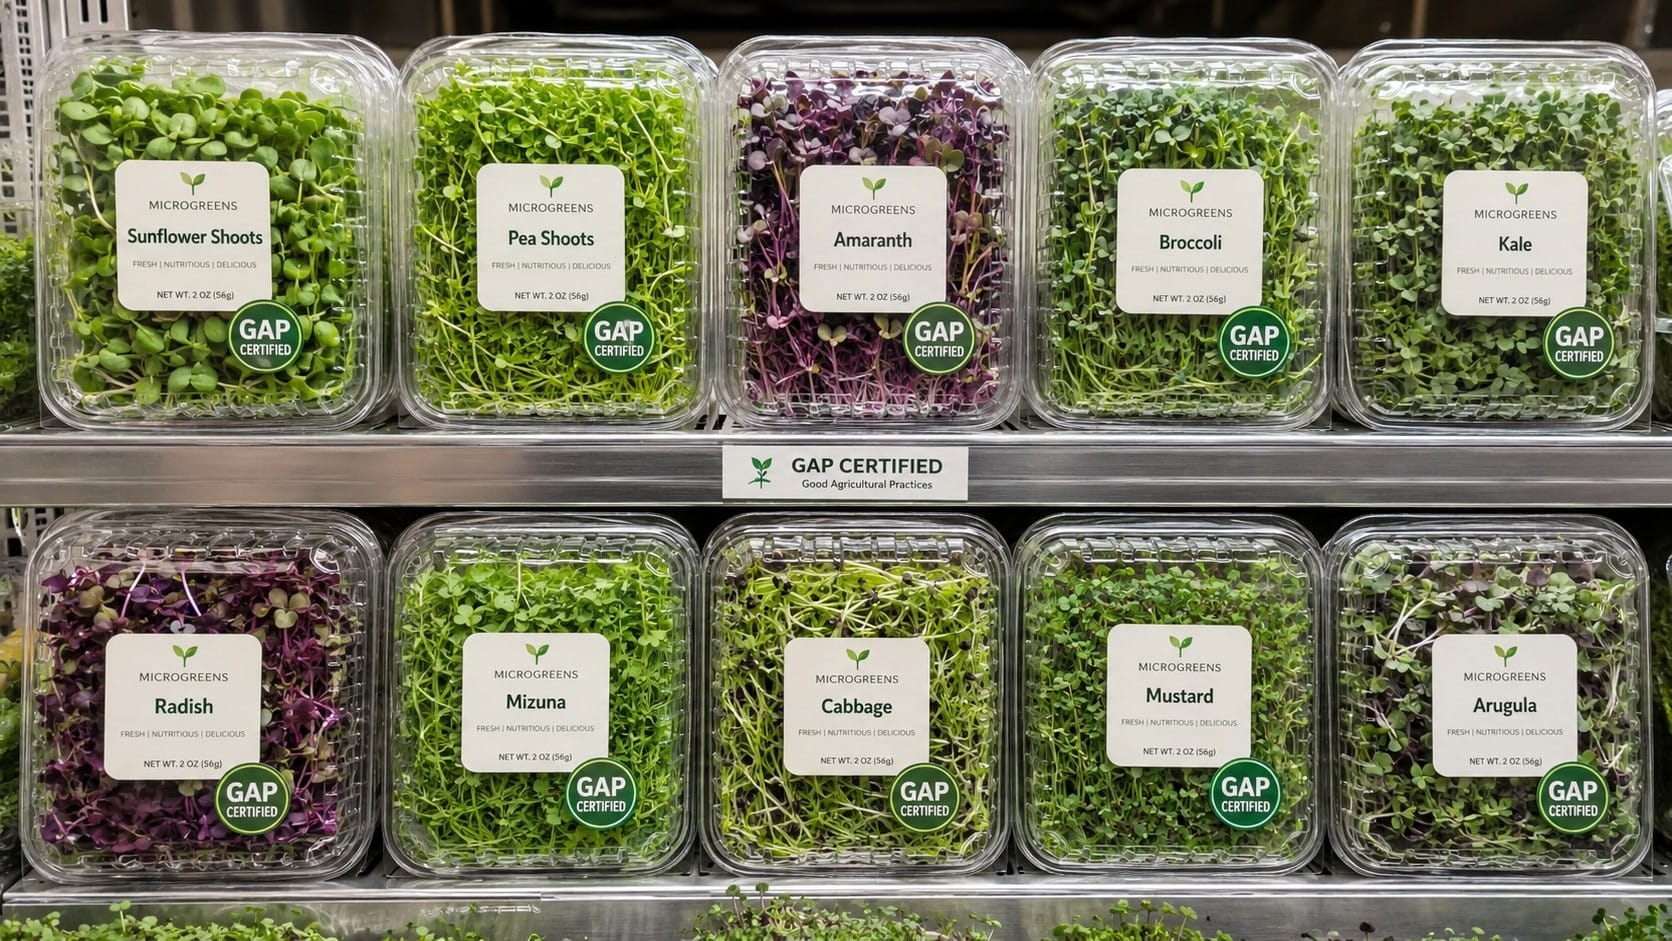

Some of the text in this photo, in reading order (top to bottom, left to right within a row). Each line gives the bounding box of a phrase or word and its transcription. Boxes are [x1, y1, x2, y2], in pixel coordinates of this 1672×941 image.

[149, 200, 238, 211] MICROGREENS
[508, 203, 594, 213] MICROGREENS
[831, 205, 916, 215] MICROGREENS
[1149, 208, 1233, 218] MICROGREENS
[1474, 209, 1557, 219] MICROGREENS
[128, 228, 263, 245] Sunflower Shoots
[509, 230, 594, 246] Pea Shoots
[834, 231, 912, 248] Amaranth
[1160, 234, 1222, 250] Broccoli
[1499, 236, 1532, 252] Kale
[133, 260, 158, 268] FRESH
[216, 261, 257, 269] DELICIOUS
[521, 262, 566, 270] NUTRITIOUS
[572, 262, 611, 270] DELICIOUS
[814, 263, 837, 271] FRESH
[843, 263, 888, 271] NUTRITIOUS
[1131, 265, 1154, 273] FRESH
[1210, 266, 1249, 274] DELICIOUS
[1486, 267, 1529, 275] NUTRITIOUS
[157, 291, 234, 301] NET WT. 2 OZ (56g)
[532, 292, 547, 300] WT.
[548, 292, 554, 300] 2
[555, 292, 567, 300] OZ
[568, 292, 589, 302] (56g)
[836, 293, 910, 303] NET WT. 2 OZ (56g)
[1193, 295, 1204, 303] OZ
[1206, 295, 1226, 304] (56g)
[1479, 296, 1494, 304] NET
[1531, 297, 1551, 306] (56g)
[239, 319, 291, 340] GAP
[594, 320, 644, 342] GAP
[914, 321, 964, 342] GAP
[1230, 326, 1280, 346] GAP
[1555, 326, 1604, 346] GAP
[240, 344, 291, 356] CERTIFIED
[595, 346, 644, 358] CERTIFIED
[915, 346, 964, 358] CERTIFIED
[1230, 349, 1279, 362] CERTIFIED
[1556, 350, 1603, 362] CERTIFIED
[792, 458, 943, 474] GAP CERTIFIED
[802, 479, 933, 491] Good Agricultural Practices
[1138, 662, 1221, 672] MICROGREENS
[139, 672, 228, 682] MICROGREENS
[494, 670, 578, 679] MICROGREENS
[816, 675, 899, 684] MICROGREENS
[1464, 672, 1546, 682] MICROGREENS
[507, 694, 566, 709] Mizuna
[1146, 687, 1213, 704] Mustard
[155, 697, 213, 714] Radish
[822, 698, 892, 718] Cabbage
[1473, 697, 1537, 717] Arugula
[1121, 718, 1144, 726] FRESH
[1199, 719, 1238, 727] DELICIOUS
[120, 730, 245, 738] FRESH NUTRITIOUS DELICIOUS
[1476, 728, 1520, 736] NUTRITIOUS
[1525, 728, 1564, 736] DELICIOUS
[499, 753, 514, 761] NET
[532, 753, 537, 761] 2
[538, 753, 550, 761] OZ
[552, 753, 572, 762] (56g)
[1143, 747, 1159, 755] NET
[1196, 748, 1216, 757] (56g)
[144, 760, 222, 770] NET WT. 2 OZ (56g)
[860, 757, 872, 765] OZ
[873, 757, 894, 766] (56g)
[1469, 757, 1542, 767] NET WT. 2 OZ (56g)
[226, 782, 278, 801] GAP
[577, 777, 626, 797] GAP
[900, 781, 949, 801] GAP
[1221, 777, 1271, 797] GAP
[1549, 780, 1598, 800] GAP
[226, 806, 278, 817] CERTIFIED
[577, 801, 625, 813] CERTIFIED
[900, 805, 949, 817] CERTIFIED
[1221, 801, 1270, 813] CERTIFIED
[1549, 804, 1598, 816] CERTIFIED
